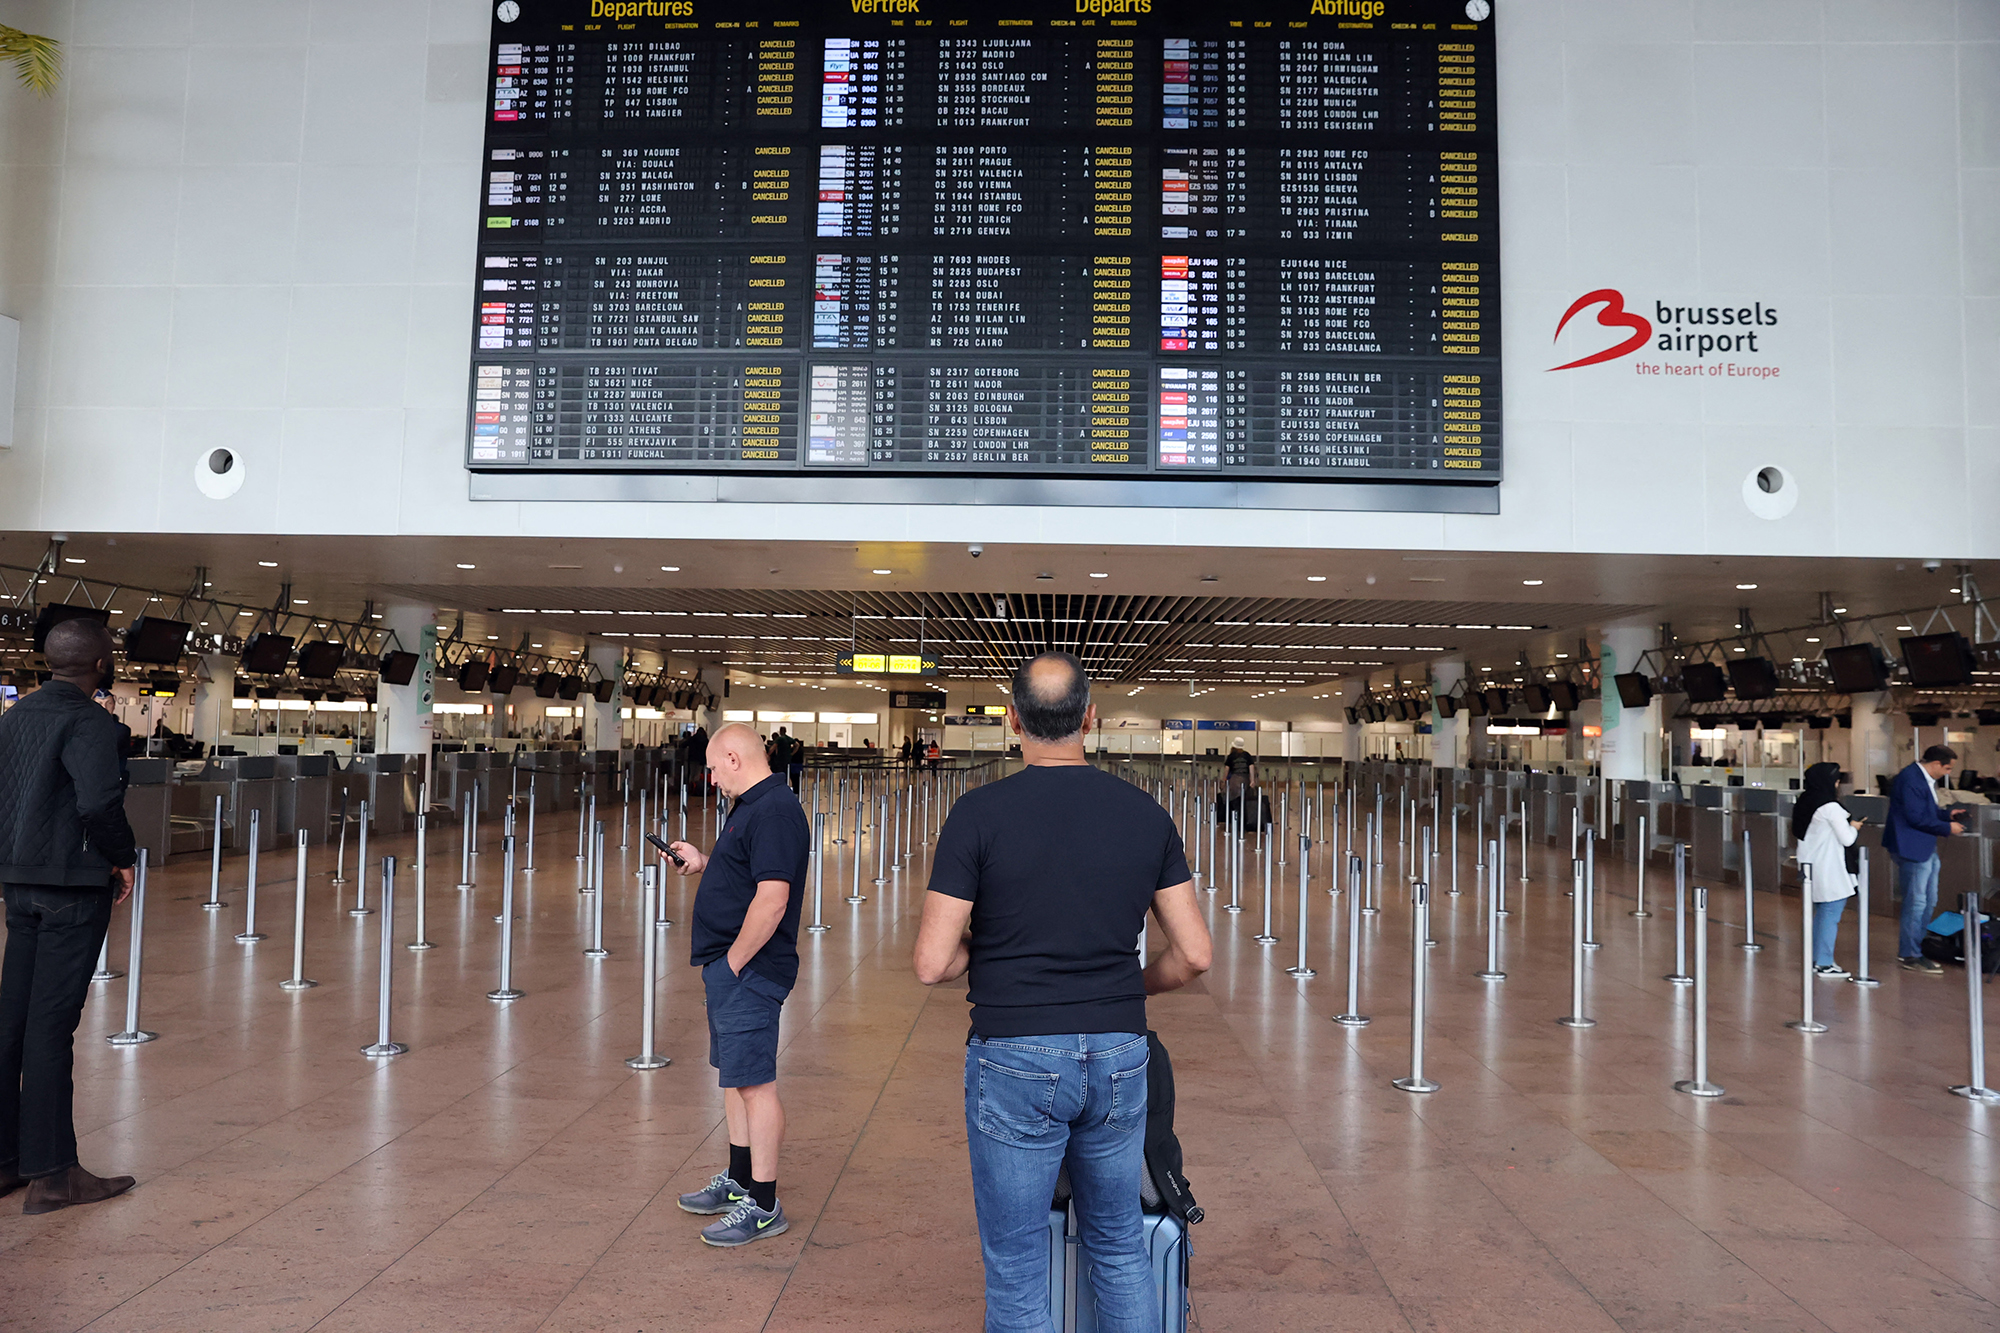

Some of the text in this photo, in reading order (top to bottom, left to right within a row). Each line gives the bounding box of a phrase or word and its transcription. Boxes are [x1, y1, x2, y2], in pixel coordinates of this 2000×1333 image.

[591, 0, 693, 20] Departures
[1076, 0, 1152, 17] Departs
[1324, 76, 1367, 84] VALENCIA
[647, 98, 677, 106] LISBON
[646, 109, 682, 117] TANGIER
[980, 158, 1011, 166] PRAGUE
[1325, 173, 1357, 181] LISBON
[1325, 185, 1357, 193] GENEVA
[641, 194, 661, 202] LOME
[1325, 208, 1369, 216] PRISTINA
[978, 227, 1010, 235] GENEVA
[977, 256, 1010, 264] RHODES
[1325, 272, 1375, 280] BARCELONA
[1326, 284, 1374, 292] FRANKFURT
[1325, 296, 1375, 304] AMSTERDAM
[636, 303, 683, 311] BARCELONA
[977, 303, 1019, 311] TENERIFE
[1656, 301, 1777, 326] brussels
[1326, 332, 1375, 340] BARCELONA
[1658, 327, 1758, 357] airport
[1326, 343, 1480, 354] CASABLANCA CANCELLED
[746, 367, 781, 375] CANCELLED
[975, 368, 1019, 376] GOTEBORG
[1636, 363, 1780, 380] the heart of Europe
[1326, 373, 1358, 381] BERLIN
[1365, 374, 1381, 382] BER
[1326, 385, 1370, 393] VALENCIA
[1326, 397, 1353, 405] NADOR
[1092, 404, 1129, 413] CANCELLED
[1326, 409, 1375, 417] FRANKFURT
[630, 414, 672, 422] ALICANTE
[1326, 421, 1359, 429] GENEVA
[629, 426, 660, 434] ATHENS
[1326, 434, 1481, 444] COPENHAGEN CANCELLED
[1012, 453, 1028, 461] BER
[1092, 454, 1128, 462] CANCELLED
[1327, 458, 1370, 466] ISTANBUL
[195, 638, 210, 649] 6.2
[224, 641, 237, 651] 6.3
